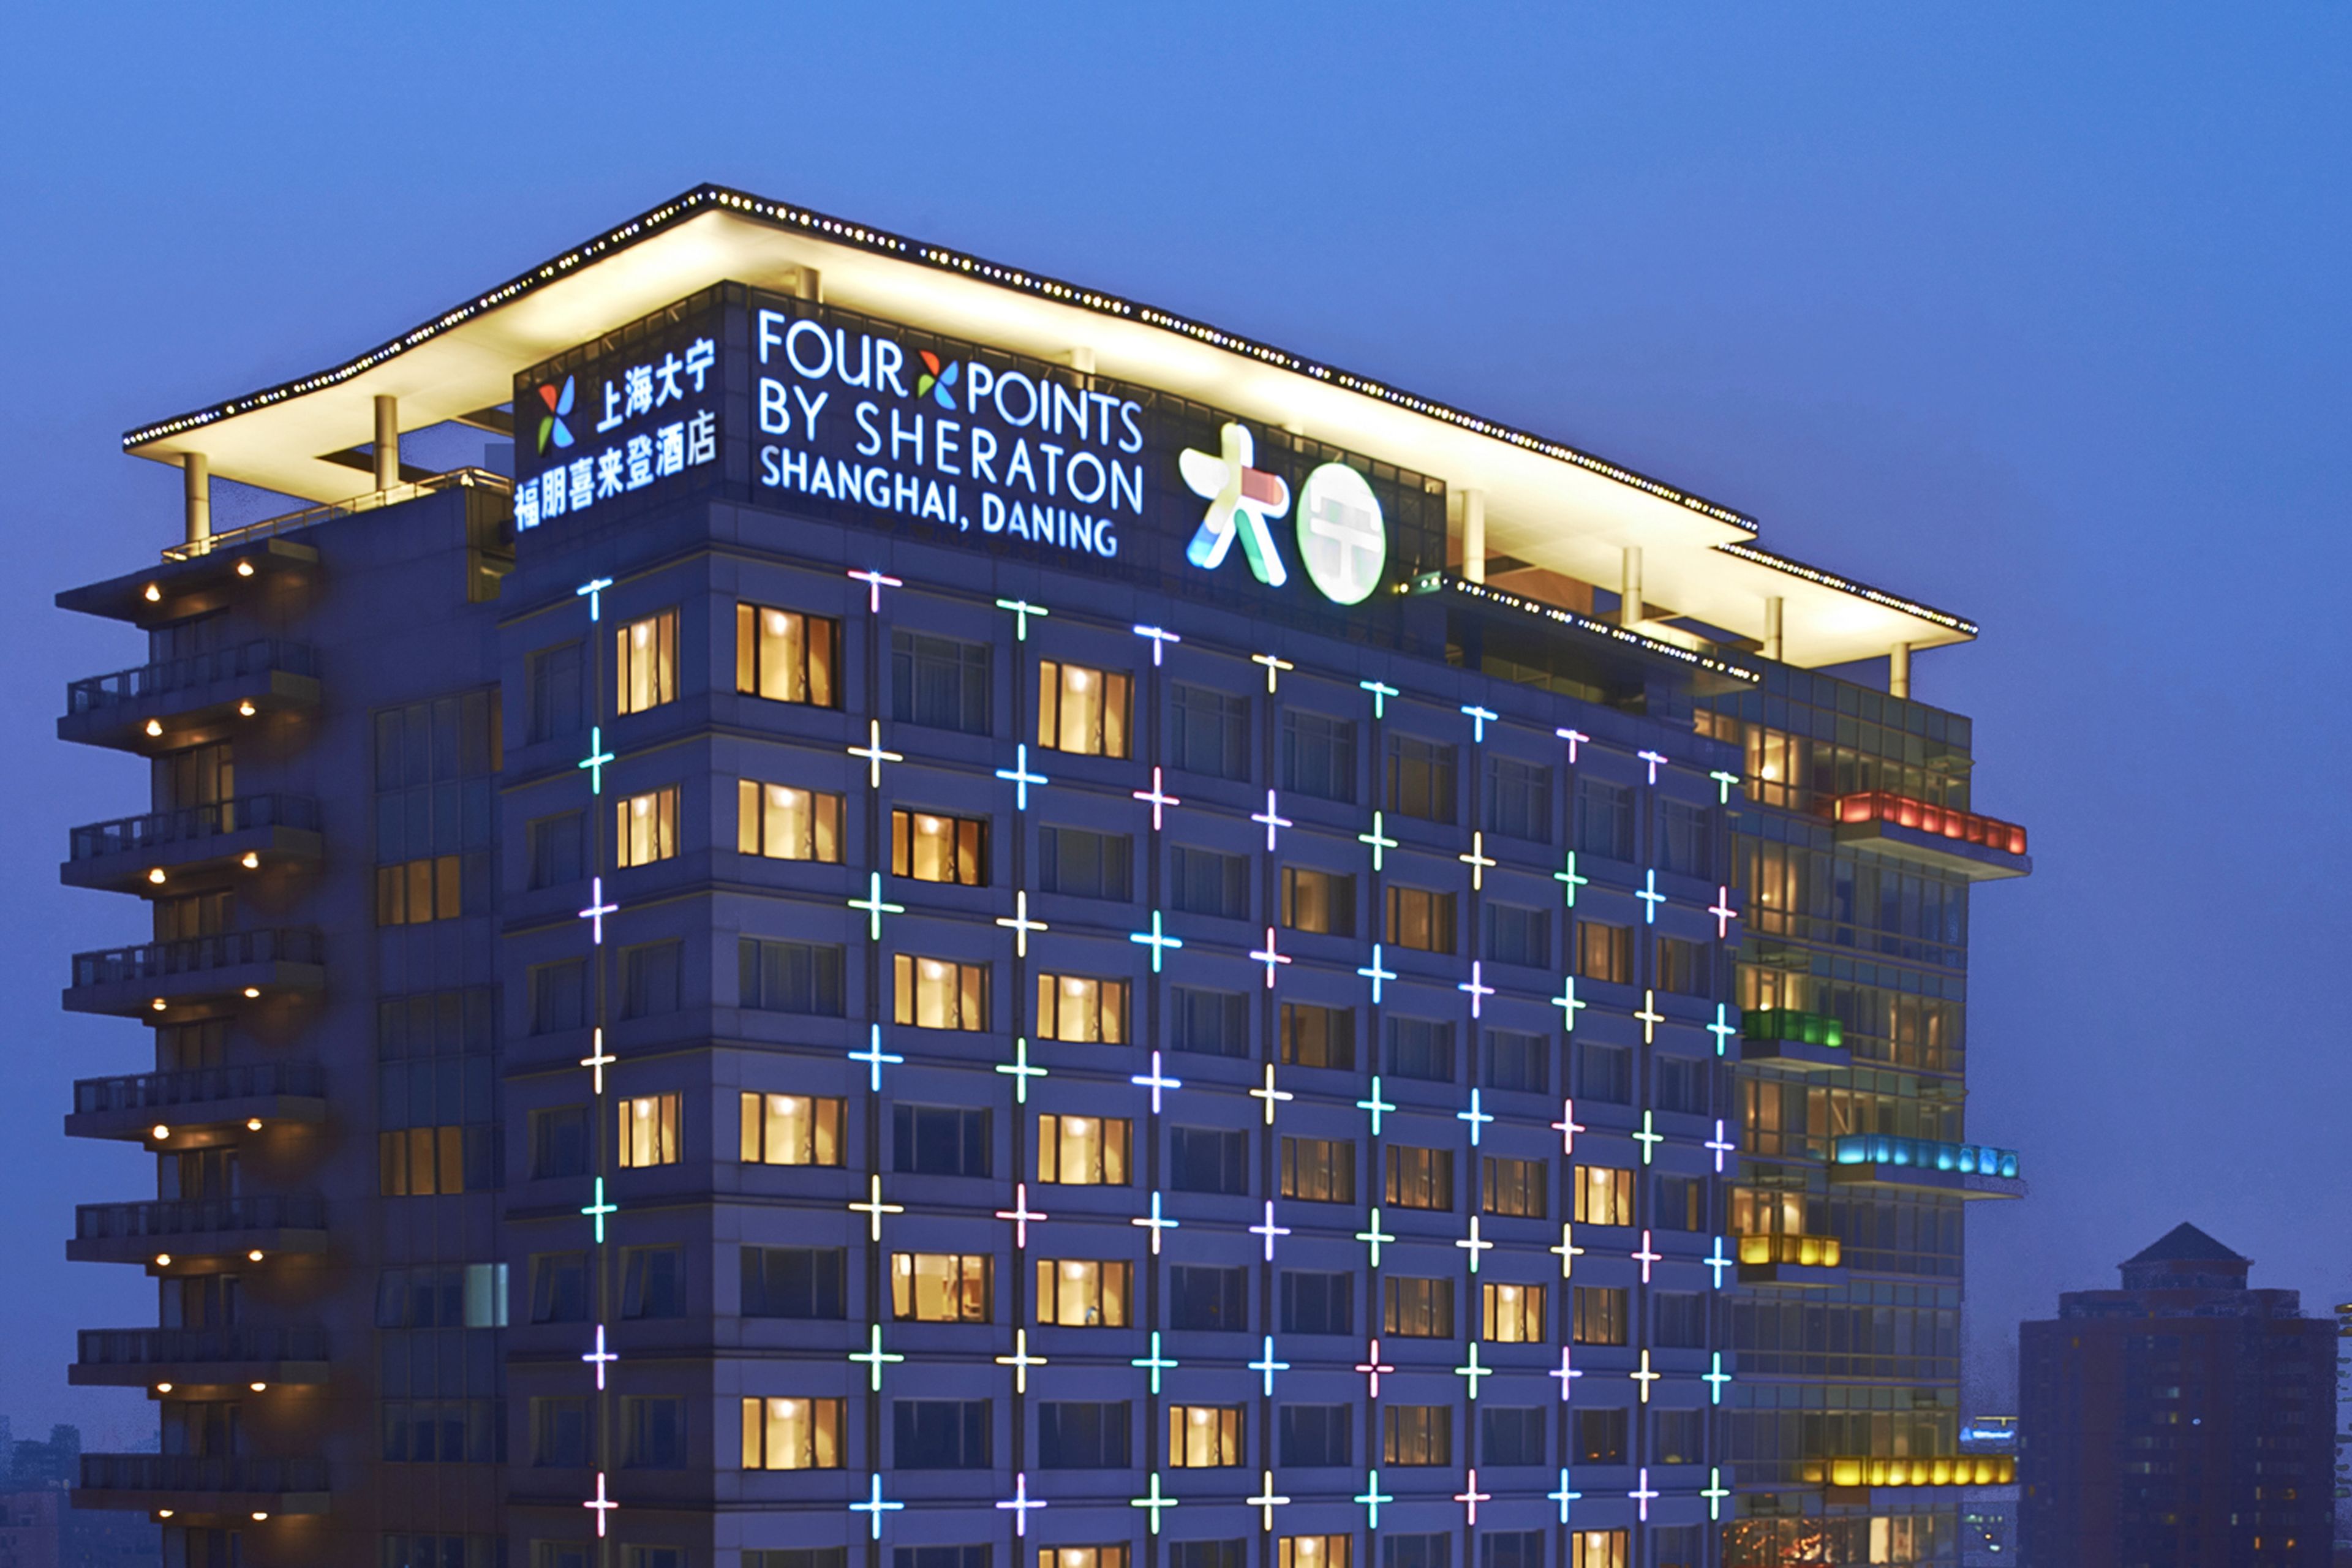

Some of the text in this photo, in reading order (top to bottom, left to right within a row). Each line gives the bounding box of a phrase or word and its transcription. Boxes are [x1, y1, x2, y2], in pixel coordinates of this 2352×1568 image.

[595, 337, 715, 434] 上海大宁
[759, 309, 1144, 453] FOUR POINTS
[513, 409, 716, 532] 福朋喜来登酒店
[760, 377, 1143, 514] BY SHERATON
[761, 445, 1117, 557] SHANGHAI, DANING
